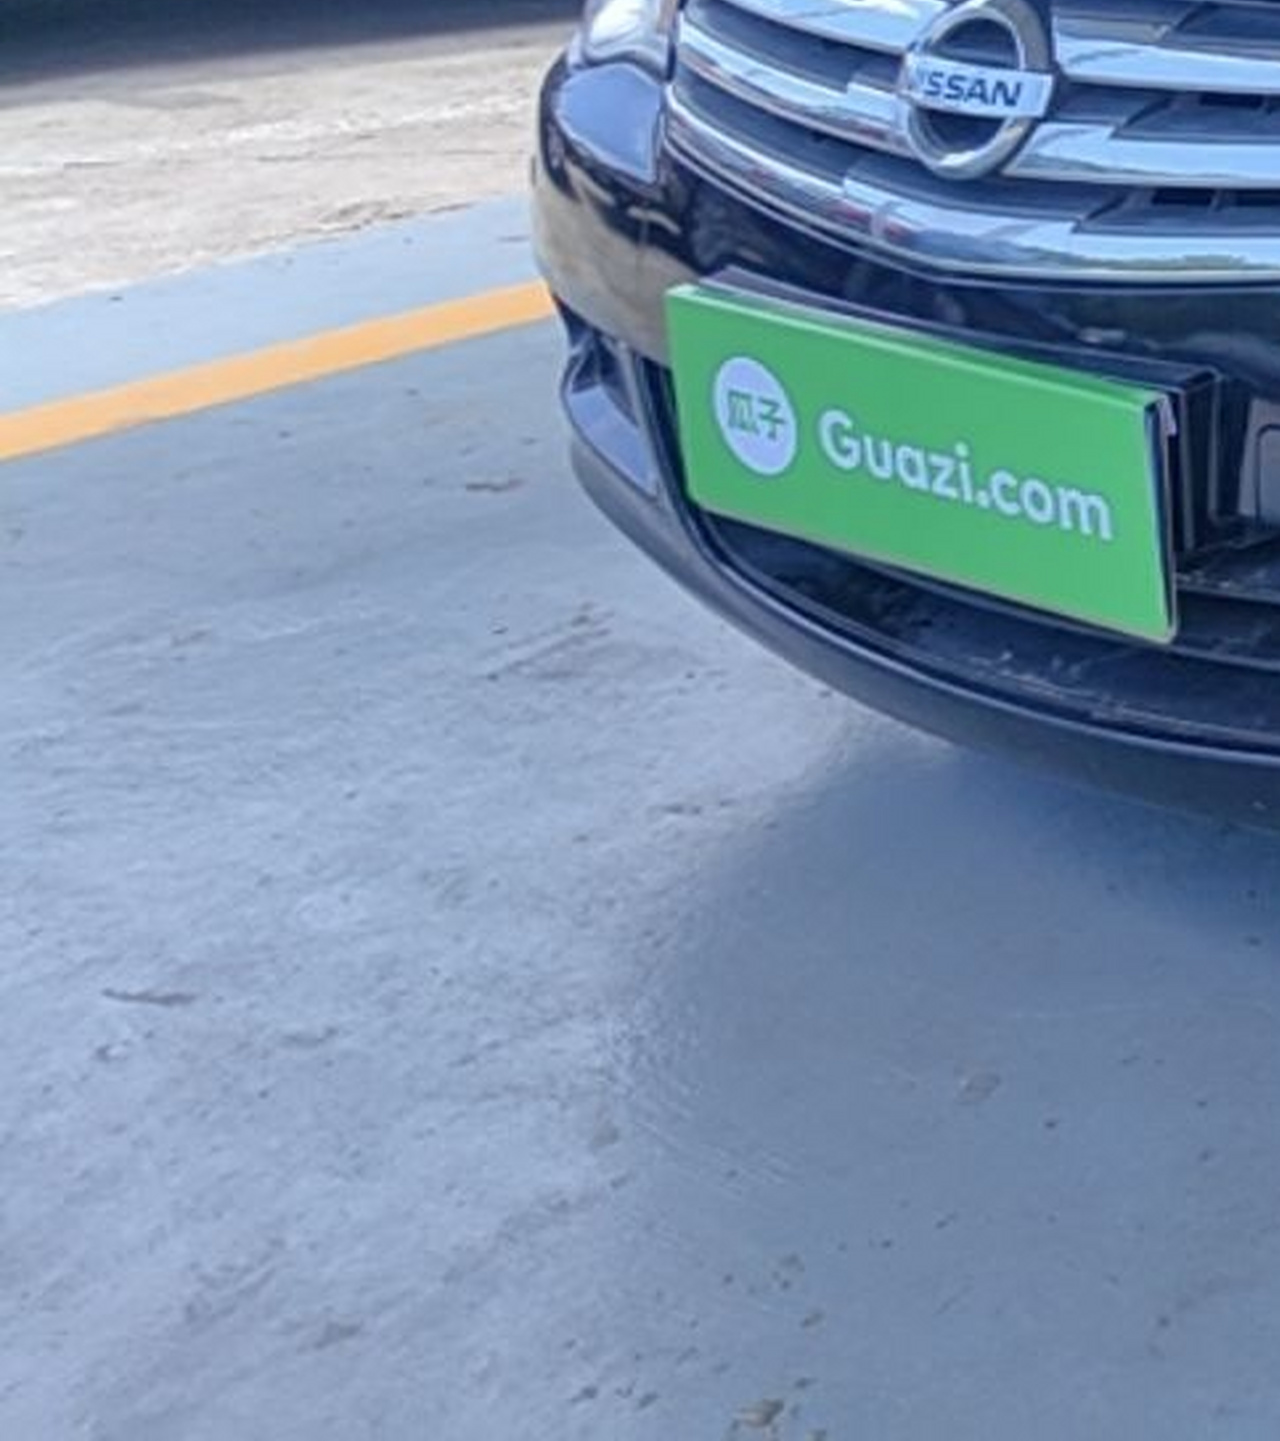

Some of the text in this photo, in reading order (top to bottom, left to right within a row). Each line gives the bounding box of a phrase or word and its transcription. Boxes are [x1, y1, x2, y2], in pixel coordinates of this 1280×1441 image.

[910, 66, 1022, 107] SSAN
[728, 389, 786, 441] 瓜子
[818, 409, 1111, 540] Guazi.com
